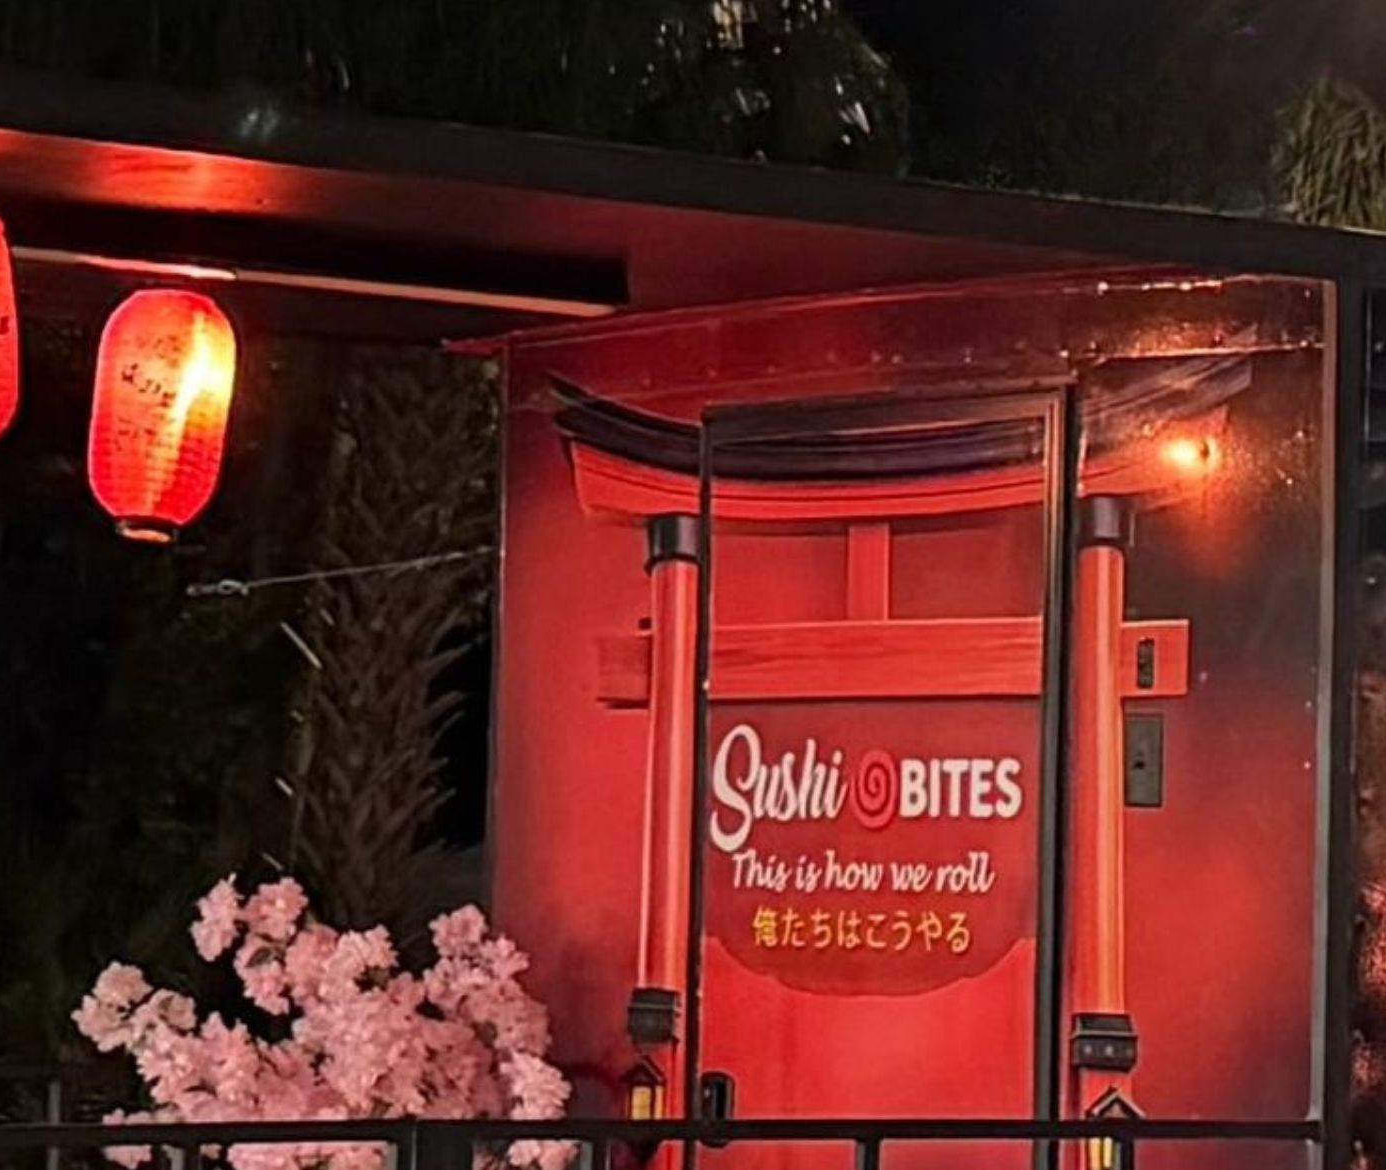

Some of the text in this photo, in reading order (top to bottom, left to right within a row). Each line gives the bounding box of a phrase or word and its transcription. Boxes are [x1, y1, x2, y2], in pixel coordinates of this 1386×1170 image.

[710, 724, 1022, 852] Sushi BITES
[732, 849, 995, 893] This is how we roll
[752, 906, 971, 953] 俺たちはこうやる
